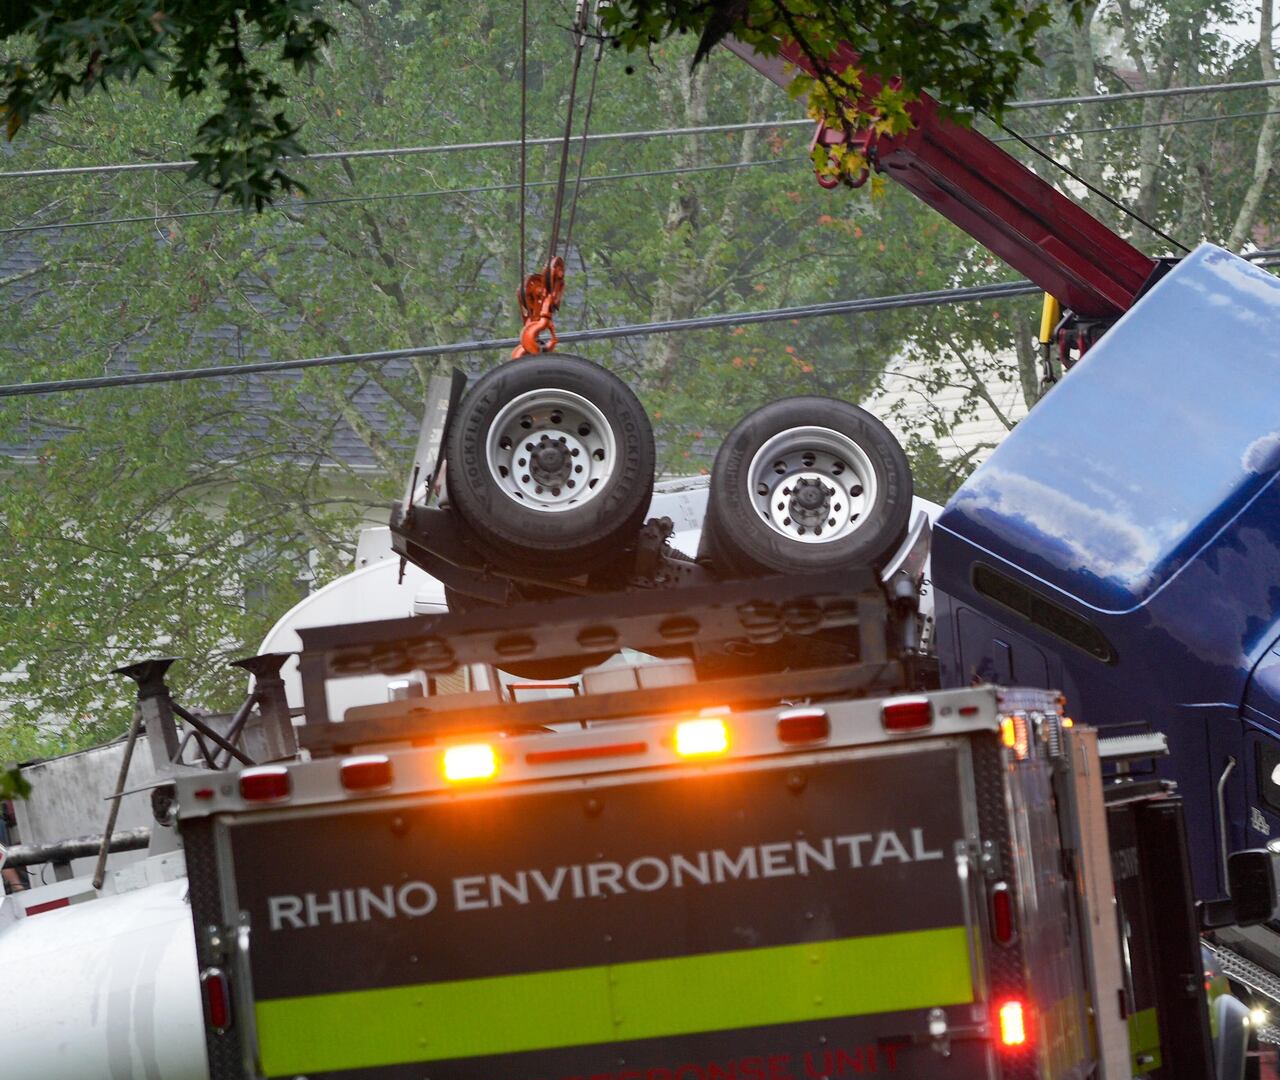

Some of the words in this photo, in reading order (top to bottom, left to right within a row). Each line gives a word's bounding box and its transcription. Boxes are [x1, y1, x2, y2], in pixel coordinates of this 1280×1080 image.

[268, 881, 438, 931] RHINO
[453, 827, 944, 912] ENVIRONMENTAL
[804, 1043, 909, 1080] UNIT
